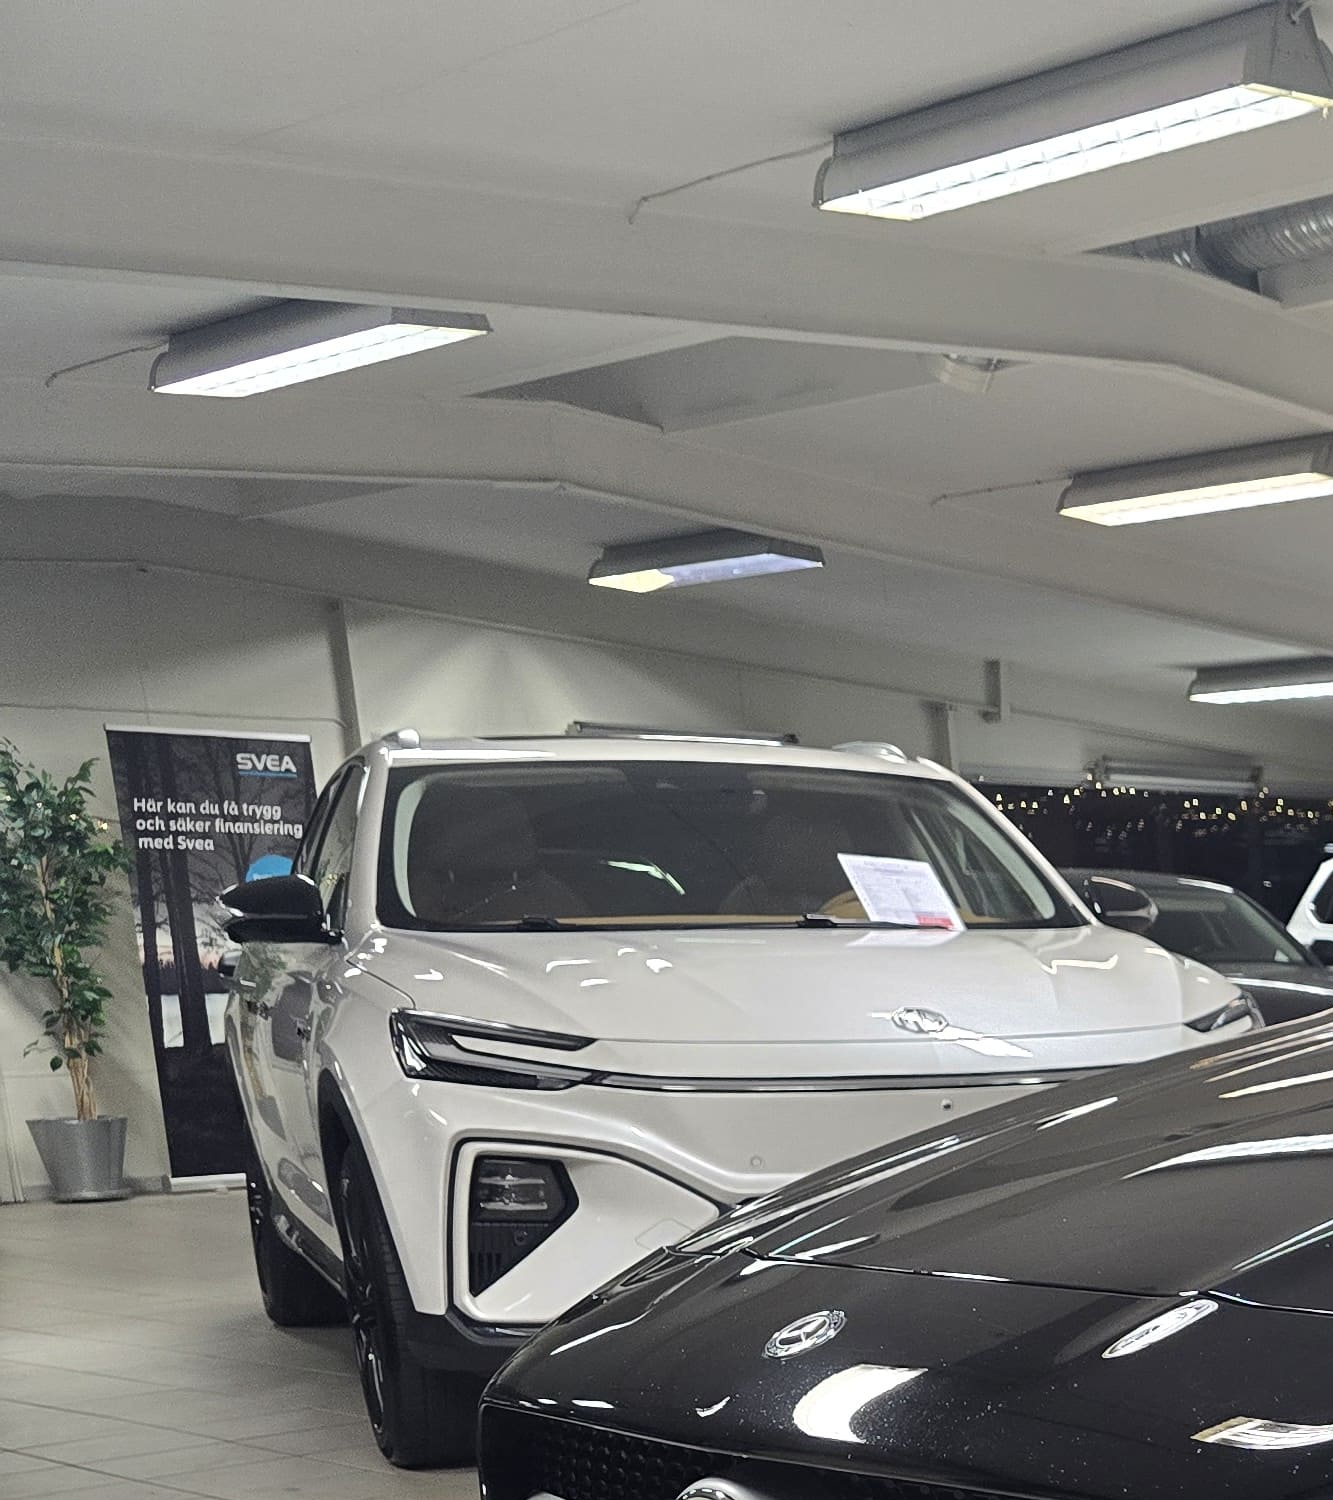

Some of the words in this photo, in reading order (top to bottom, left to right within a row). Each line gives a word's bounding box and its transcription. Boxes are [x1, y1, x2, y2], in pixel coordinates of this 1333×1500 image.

[235, 752, 298, 773] SVEA
[132, 798, 164, 814] Här
[167, 798, 196, 815] kan
[199, 800, 220, 816] du
[223, 801, 239, 816] få
[242, 803, 282, 820] trygg
[135, 818, 166, 832] och
[169, 818, 211, 834] säker
[214, 819, 304, 839] finansiering
[137, 835, 174, 850] med
[177, 835, 216, 851] Svea
